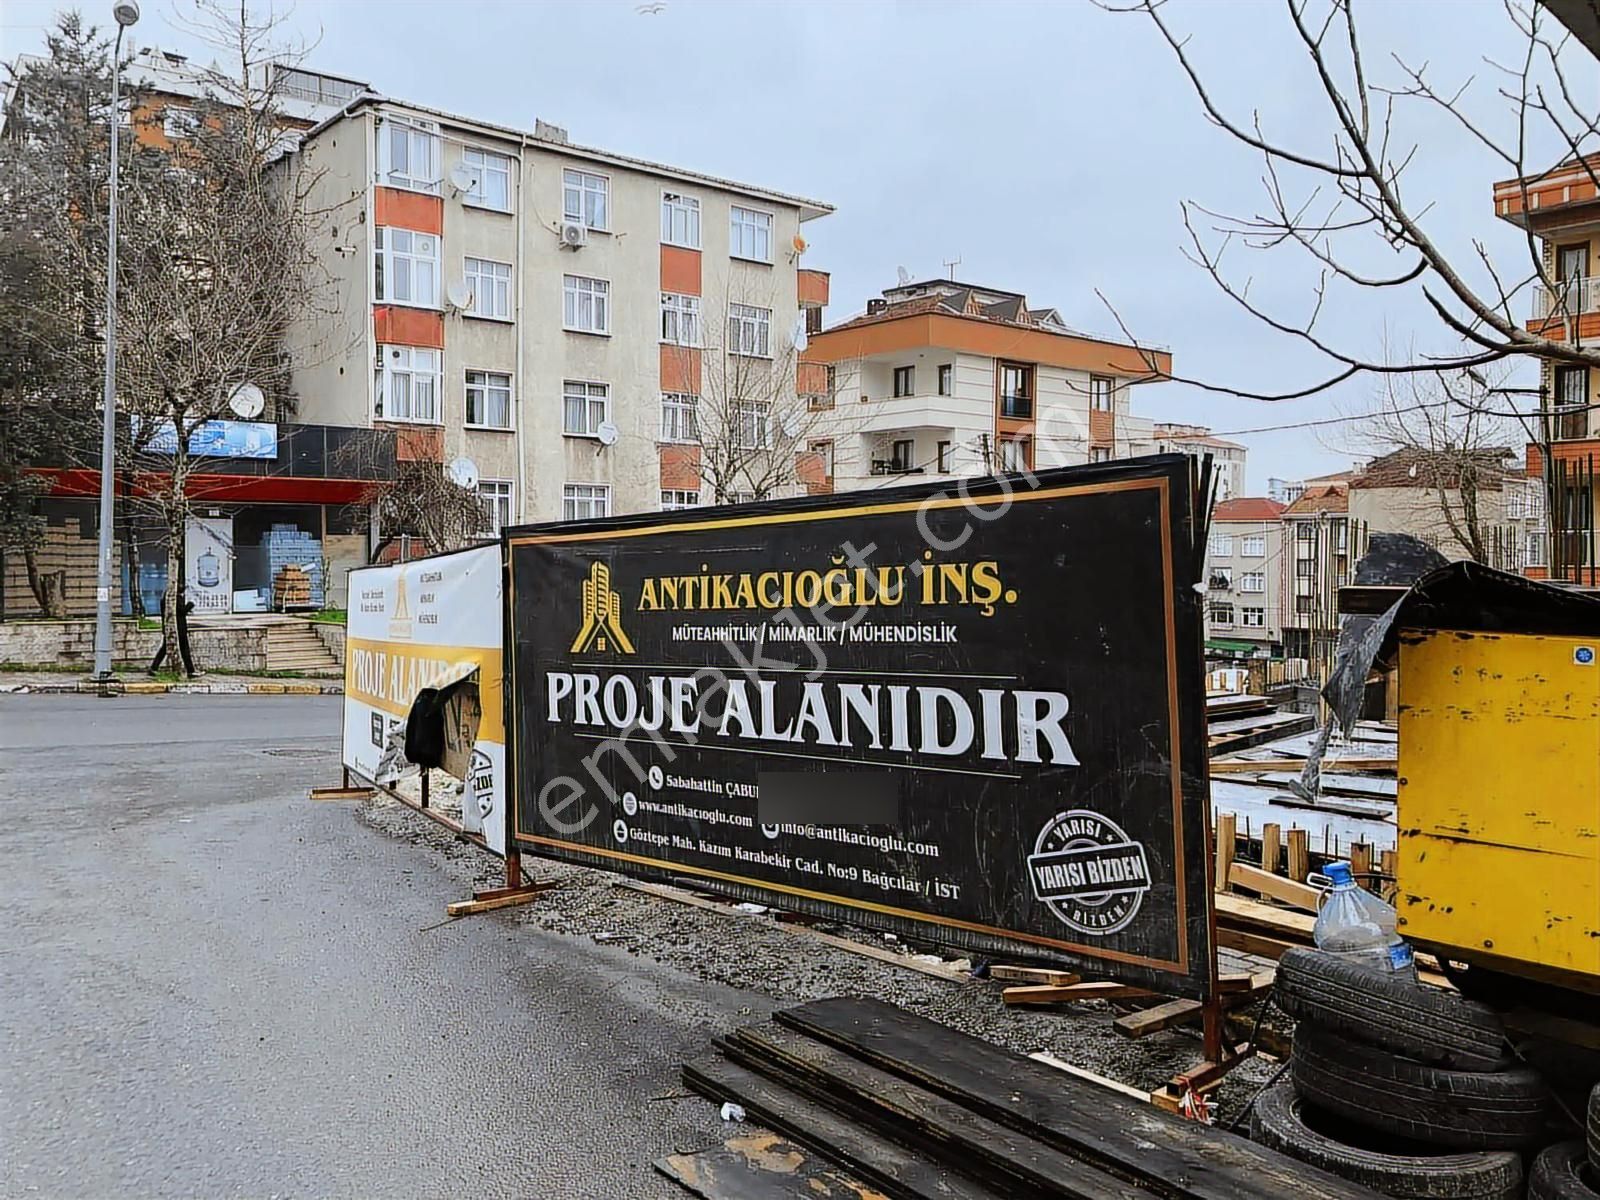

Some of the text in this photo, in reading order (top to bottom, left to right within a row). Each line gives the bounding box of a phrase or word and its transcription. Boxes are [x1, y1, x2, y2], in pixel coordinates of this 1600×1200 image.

[637, 550, 1019, 616] ANTİKACIOĞLU İNŞ.
[672, 622, 758, 642] MÜTEAHHİTLİK
[769, 623, 837, 642] MİMARLIK
[850, 621, 958, 643] MÜHENDİSLİK
[352, 648, 387, 699] PROJE
[546, 672, 1081, 766] PROJE ALANIDIR
[666, 774, 759, 799] Sabahattin ÇABU
[1053, 819, 1101, 841] YARISI
[629, 827, 670, 847] Göztepe
[672, 834, 697, 851] Mah.
[699, 839, 732, 857] Kazım
[734, 845, 792, 869] Karabekir
[795, 857, 824, 875] Cad.
[827, 862, 858, 881] No:9
[934, 877, 961, 900] İST
[1035, 855, 1145, 890] YARISI BİZDEN
